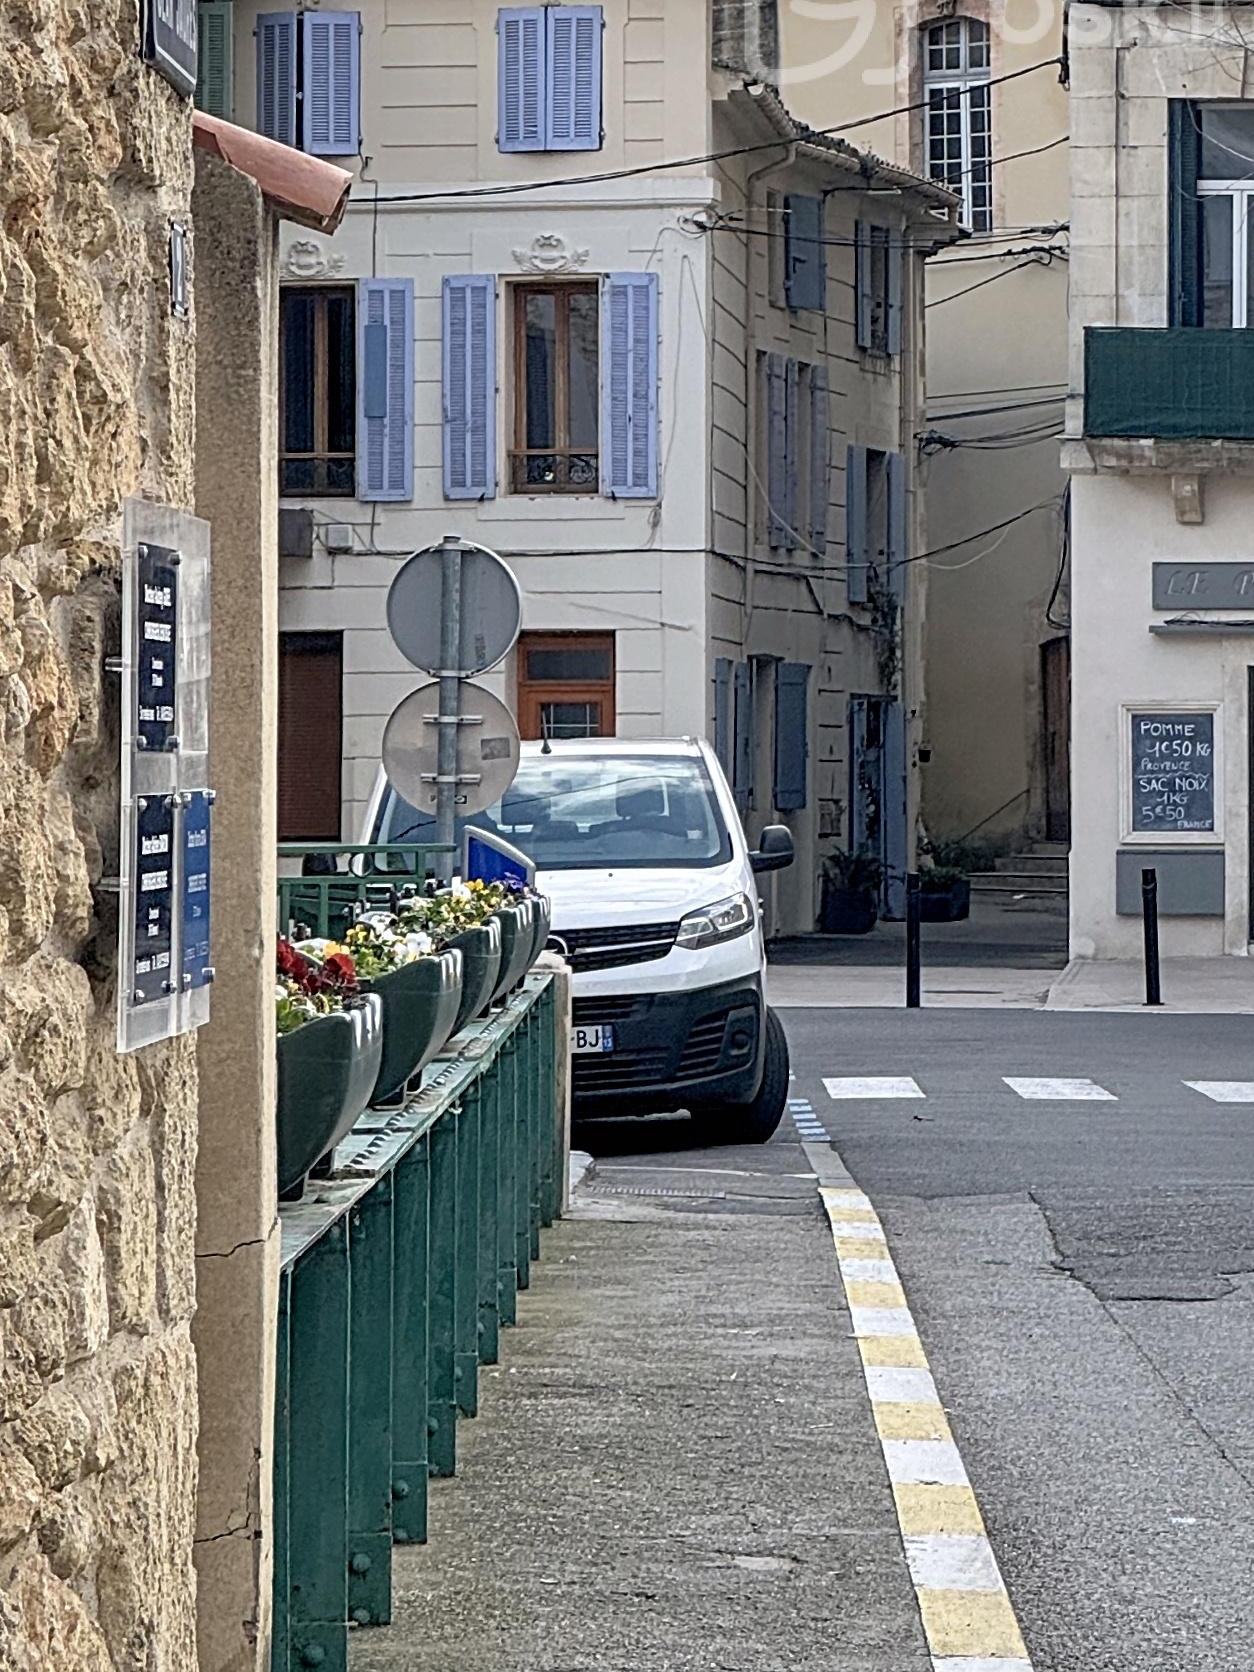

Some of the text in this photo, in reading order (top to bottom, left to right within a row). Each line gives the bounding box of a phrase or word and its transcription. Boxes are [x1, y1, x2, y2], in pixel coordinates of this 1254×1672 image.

[176, 236, 183, 301] 2
[1163, 569, 1211, 596] LE
[1140, 721, 1196, 736] POMME
[1139, 777, 1169, 793] SAC
